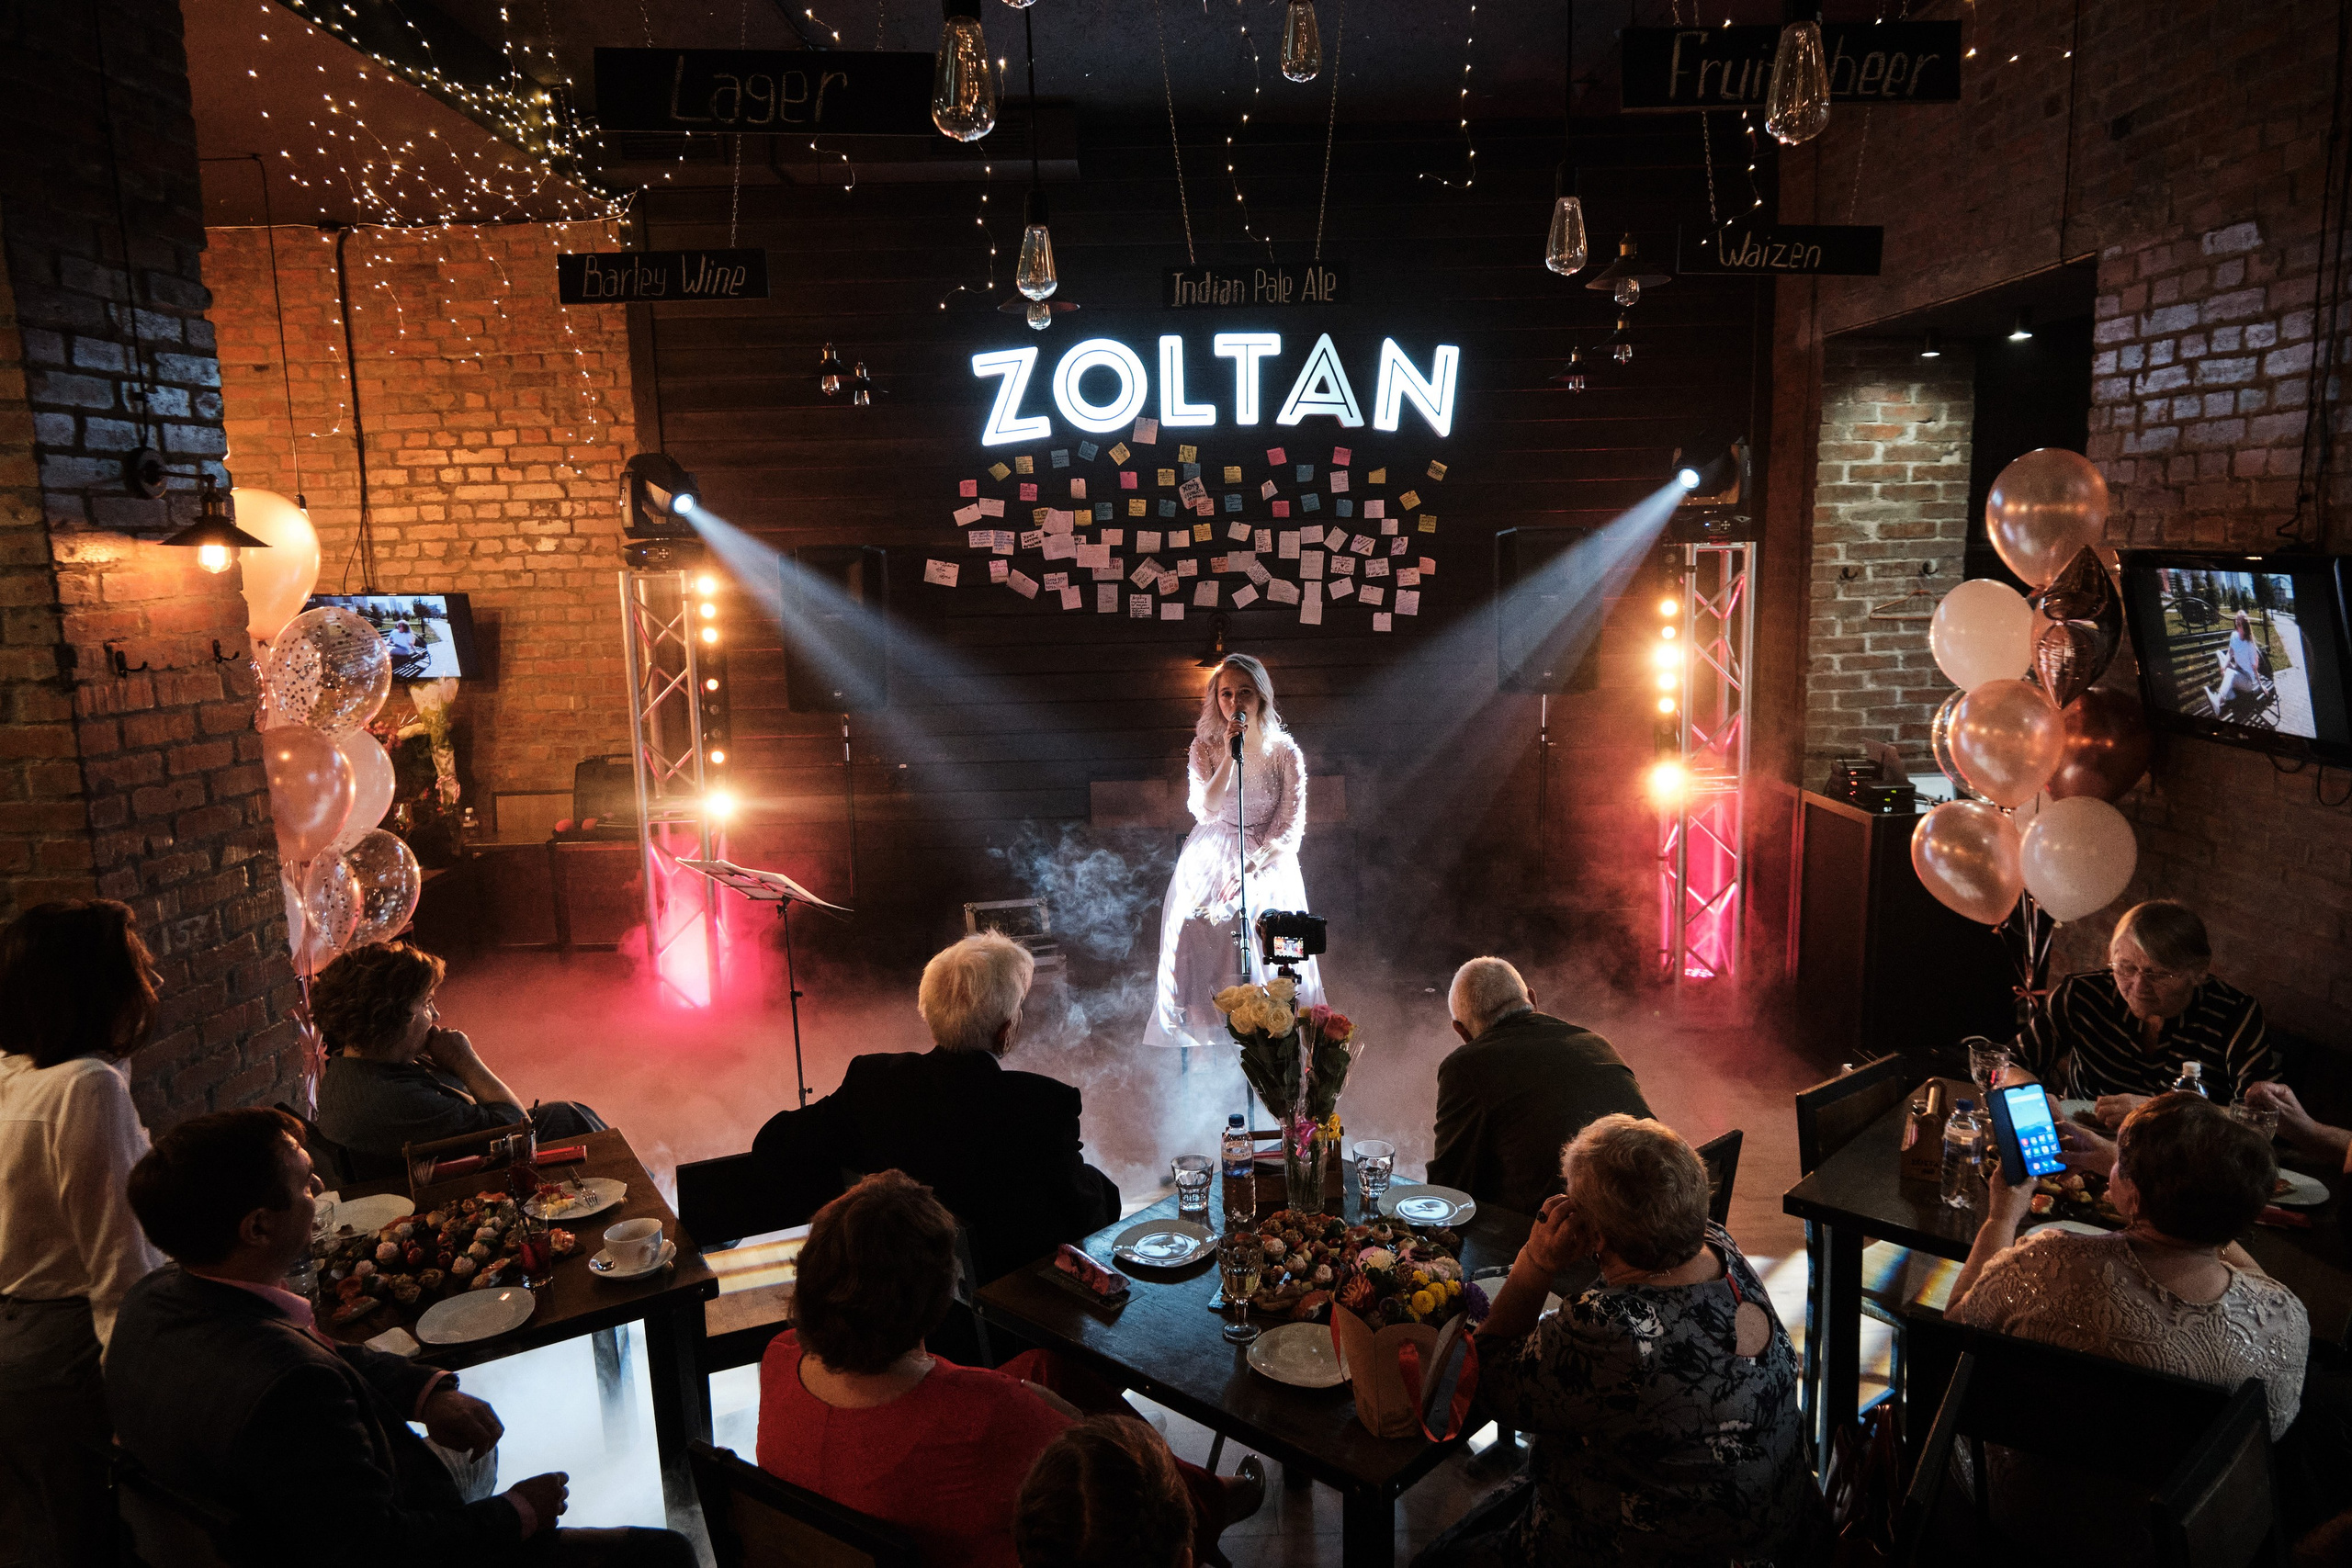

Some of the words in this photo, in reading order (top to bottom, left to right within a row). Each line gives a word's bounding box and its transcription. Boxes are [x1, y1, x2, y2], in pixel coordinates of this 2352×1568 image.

[670, 55, 848, 124] Lager
[1669, 31, 1776, 100] Frui
[1828, 37, 1940, 98] beer
[582, 254, 666, 298] Barley
[681, 254, 746, 296] Wine
[1718, 231, 1823, 268] Waizen
[1171, 271, 1246, 308] Indian
[1254, 267, 1293, 304] Pale
[1301, 266, 1337, 303] Ale
[972, 333, 1460, 446] ZOLTAN
